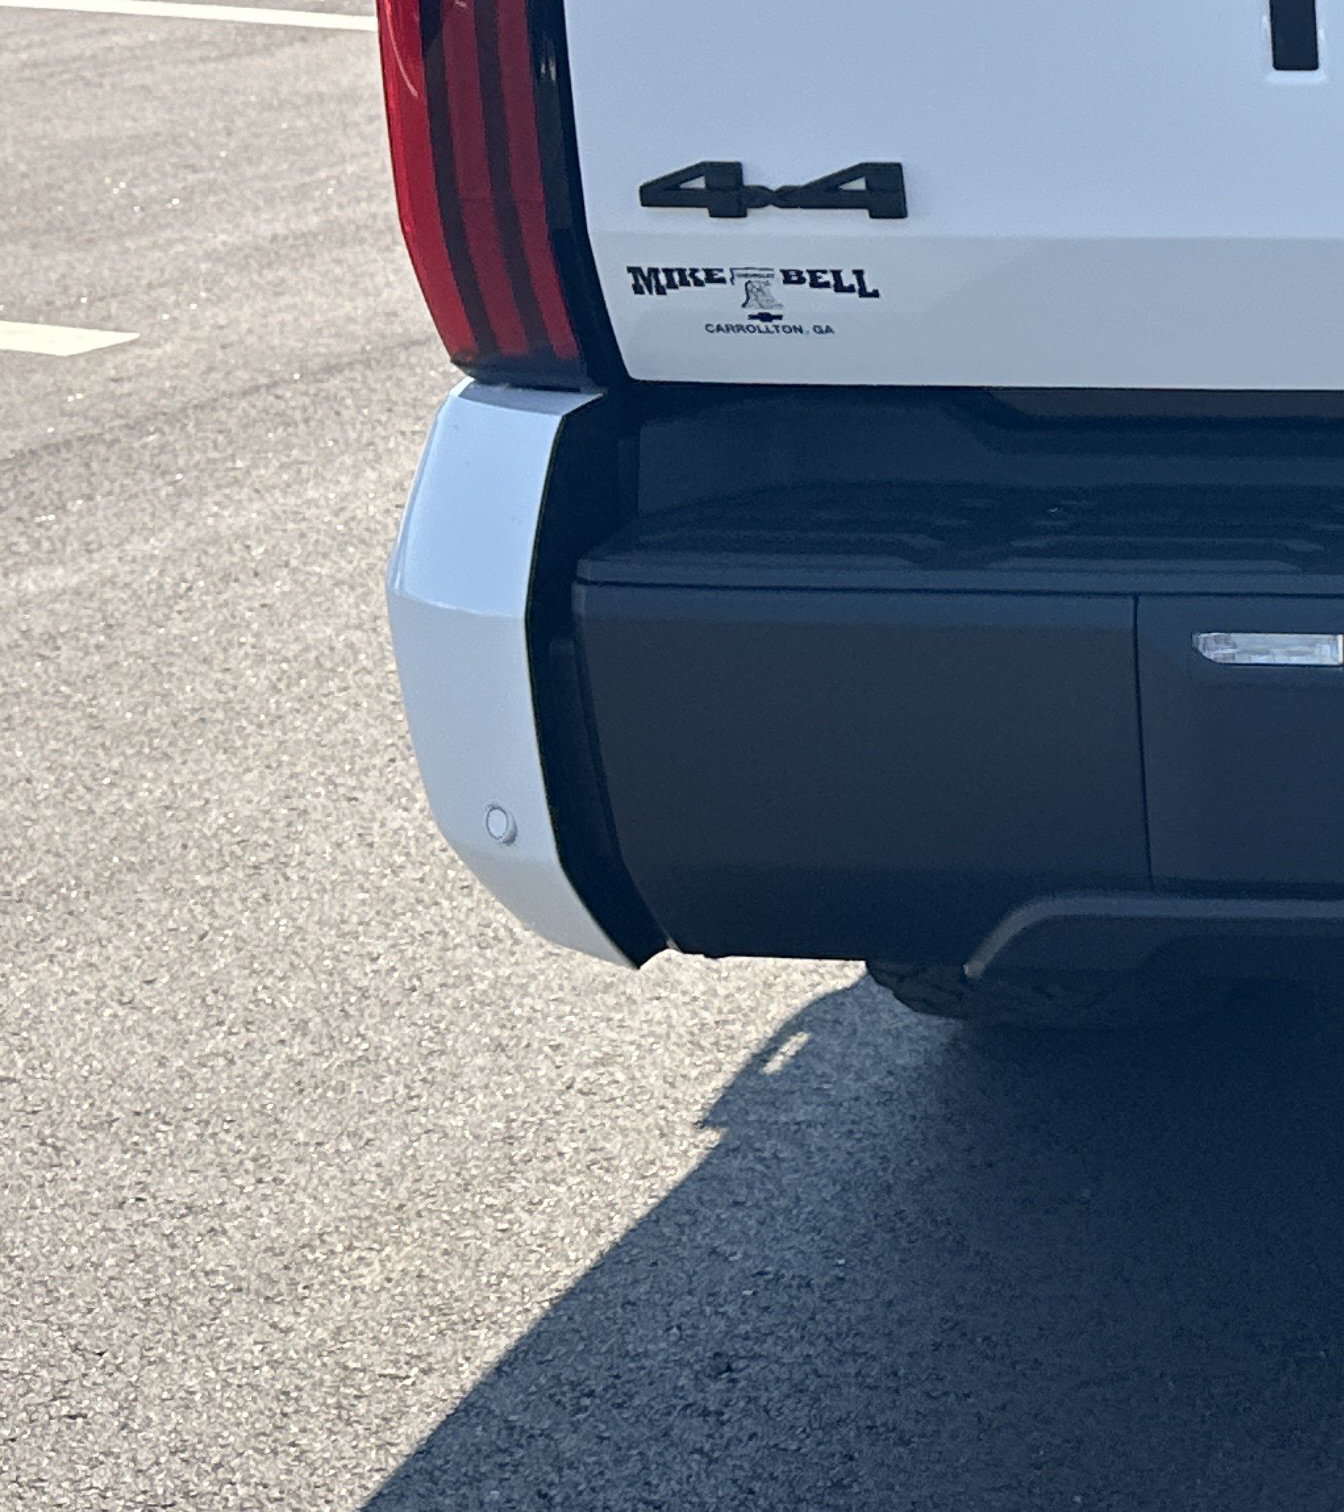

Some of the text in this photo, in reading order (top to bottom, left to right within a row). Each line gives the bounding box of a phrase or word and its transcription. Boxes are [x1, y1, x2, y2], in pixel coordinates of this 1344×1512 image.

[626, 265, 880, 298] MIKE BELL
[812, 324, 836, 336] GA
